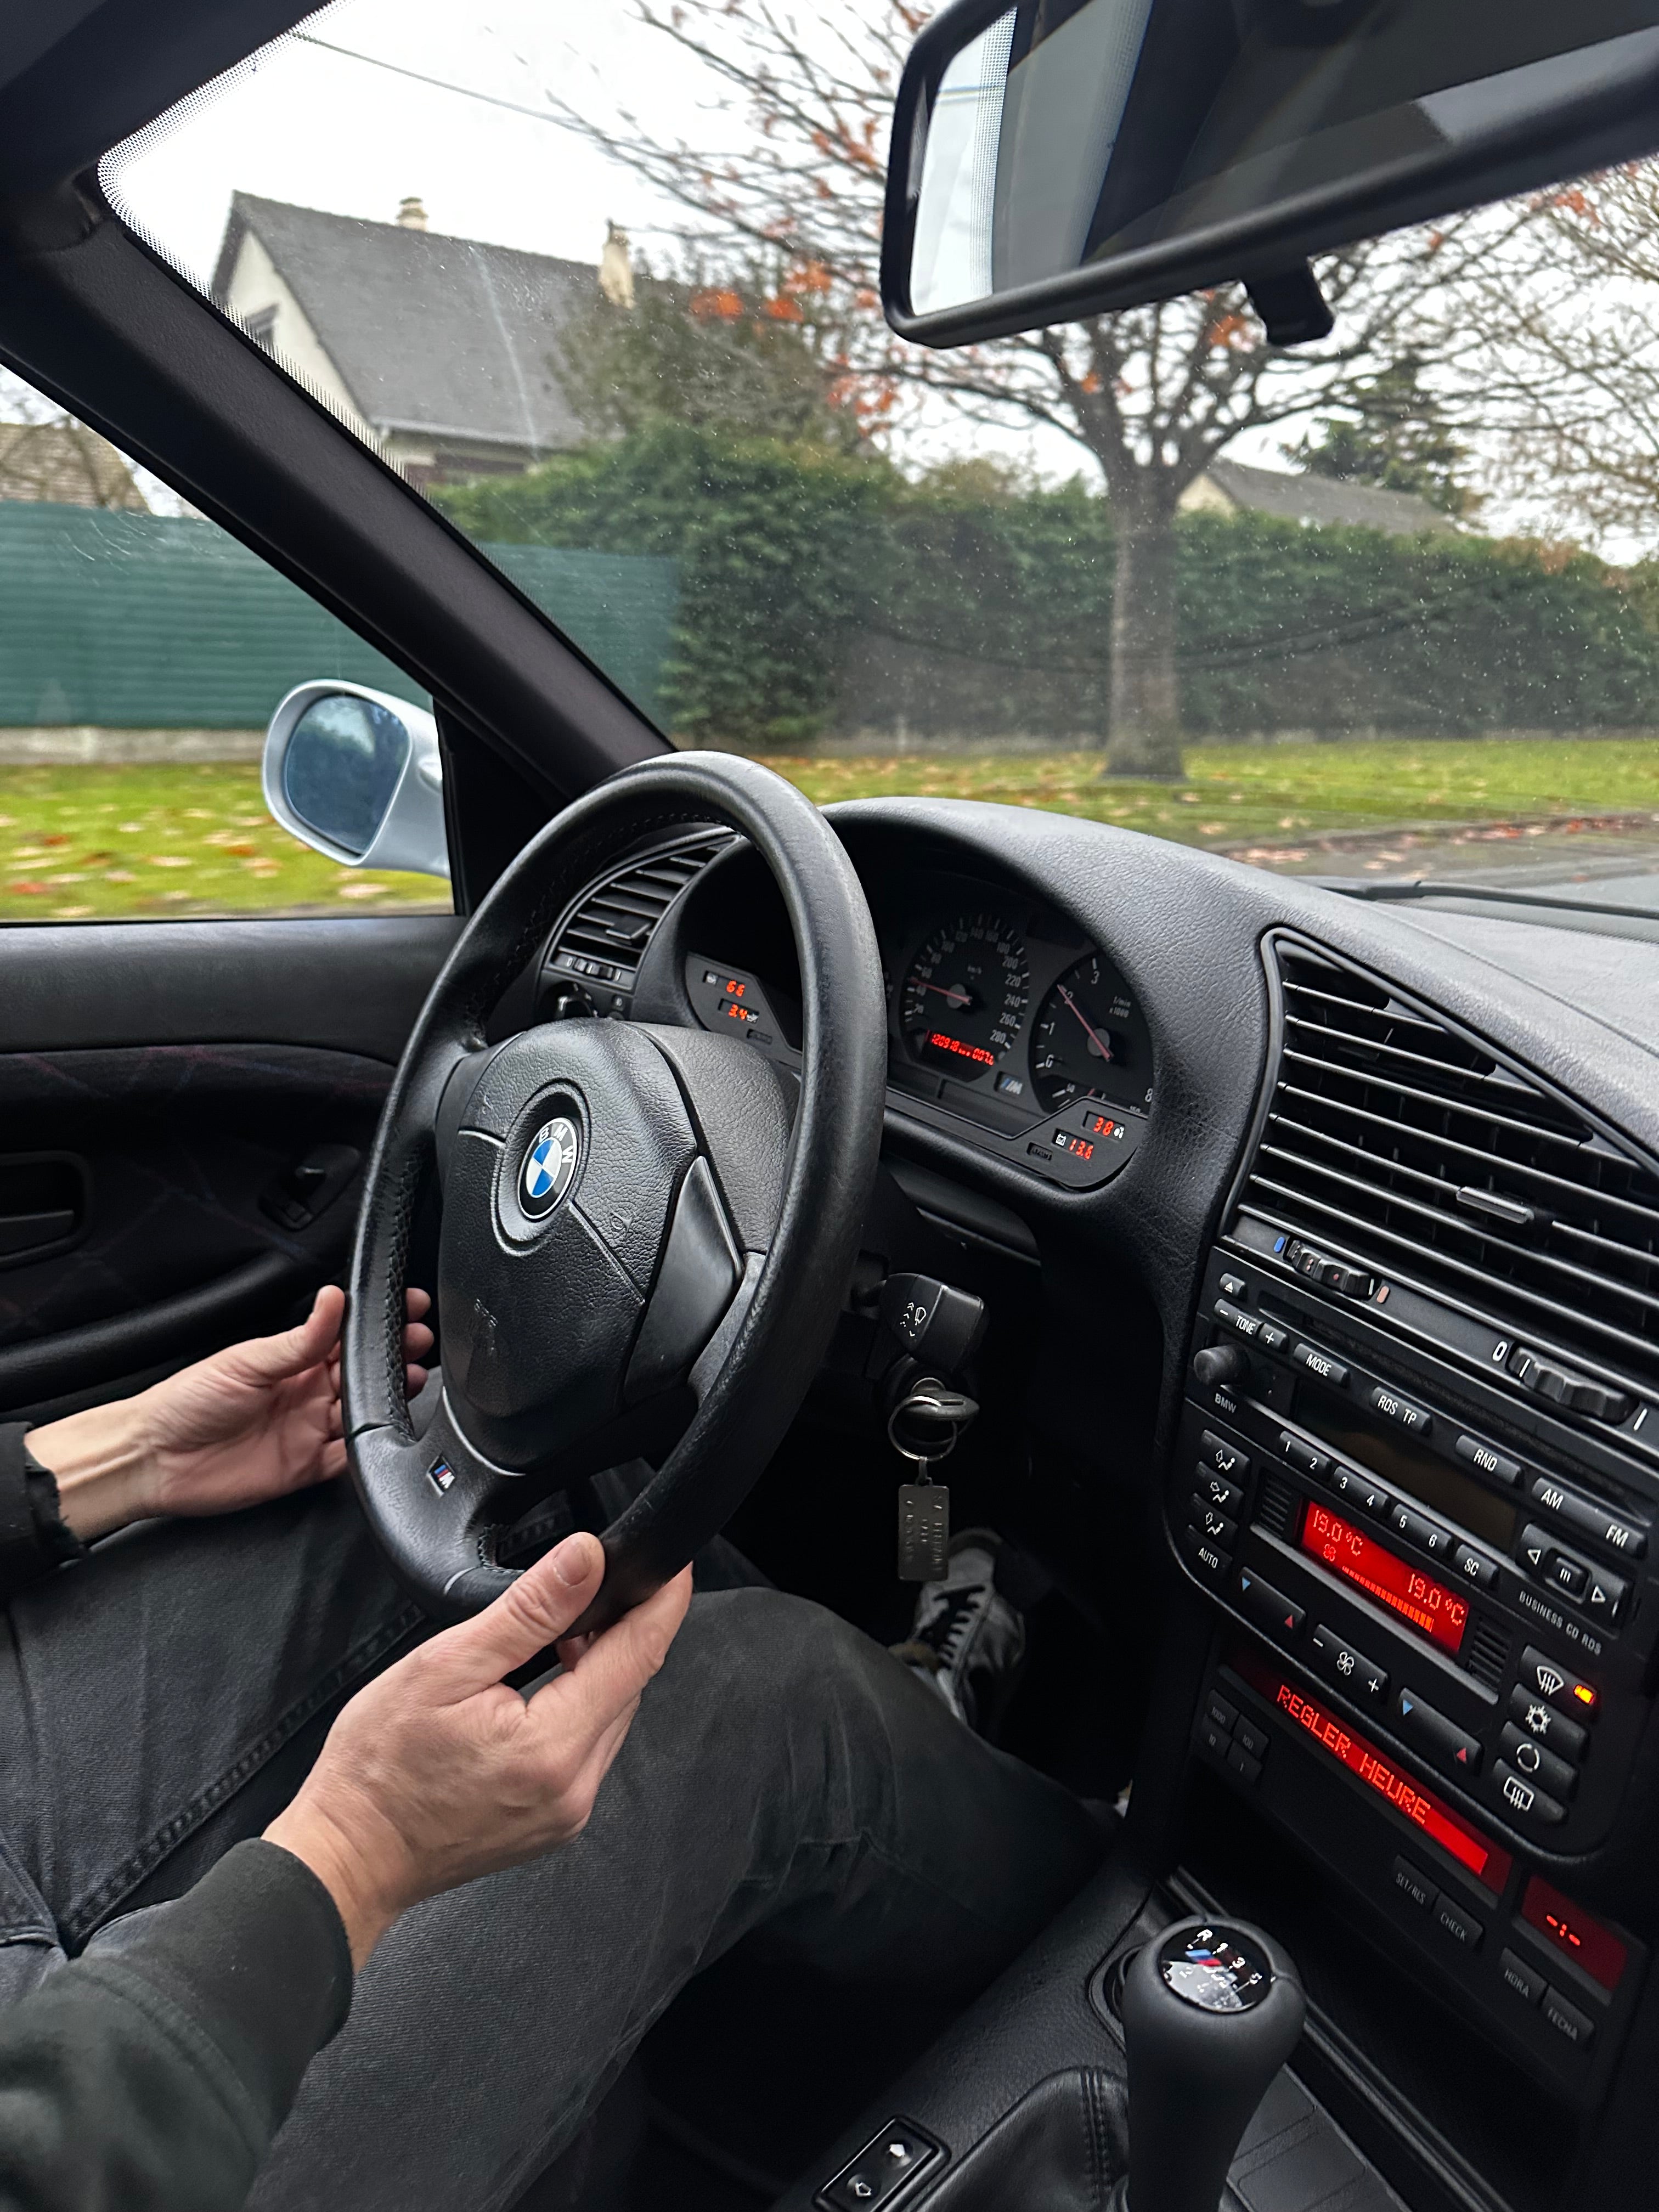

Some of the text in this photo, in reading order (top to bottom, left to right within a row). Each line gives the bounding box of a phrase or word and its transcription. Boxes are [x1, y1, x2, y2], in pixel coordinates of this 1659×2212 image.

[1002, 955, 1018, 969] 200
[1005, 973, 1022, 988] 220
[1091, 970, 1100, 985] 3
[1005, 994, 1021, 1008] 240
[1000, 1013, 1016, 1028] 260
[1048, 1022, 1054, 1035] 1
[990, 1029, 1007, 1044] 280
[1144, 1088, 1153, 1102] 8
[1093, 1116, 1114, 1136] 38
[538, 1124, 573, 1164] BMW
[1235, 1315, 1256, 1335] TONE
[1306, 1353, 1332, 1377] MODE
[1214, 1392, 1237, 1414] BMW
[1378, 1395, 1417, 1426] RDS TP
[1285, 1441, 1291, 1452] 1
[1309, 1457, 1318, 1470] 2
[1473, 1448, 1498, 1472] RND
[1339, 1476, 1348, 1489] 3
[1367, 1494, 1375, 1506] 4
[1541, 1488, 1564, 1510] AM
[1313, 1509, 1343, 1543] 19.0
[1399, 1514, 1408, 1529] 5
[1429, 1533, 1438, 1548] 6
[1606, 1524, 1629, 1548] FM
[1198, 1547, 1218, 1569] AUTO
[1464, 1558, 1480, 1577] SC
[1408, 1573, 1441, 1610] 19.0
[1519, 1590, 1602, 1656] BUSINESS CD RDS
[1211, 1706, 1226, 1725] 1000
[1242, 1734, 1254, 1750] 100
[1277, 1685, 1431, 1825] REGLER HEURE
[1395, 1872, 1426, 1905] SET/RES
[1197, 1929, 1213, 1942] R
[1440, 1912, 1468, 1942] CHECK
[1232, 1956, 1246, 1968] 3
[1504, 1968, 1530, 1999] HORA
[1547, 2008, 1578, 2041] FECHA
